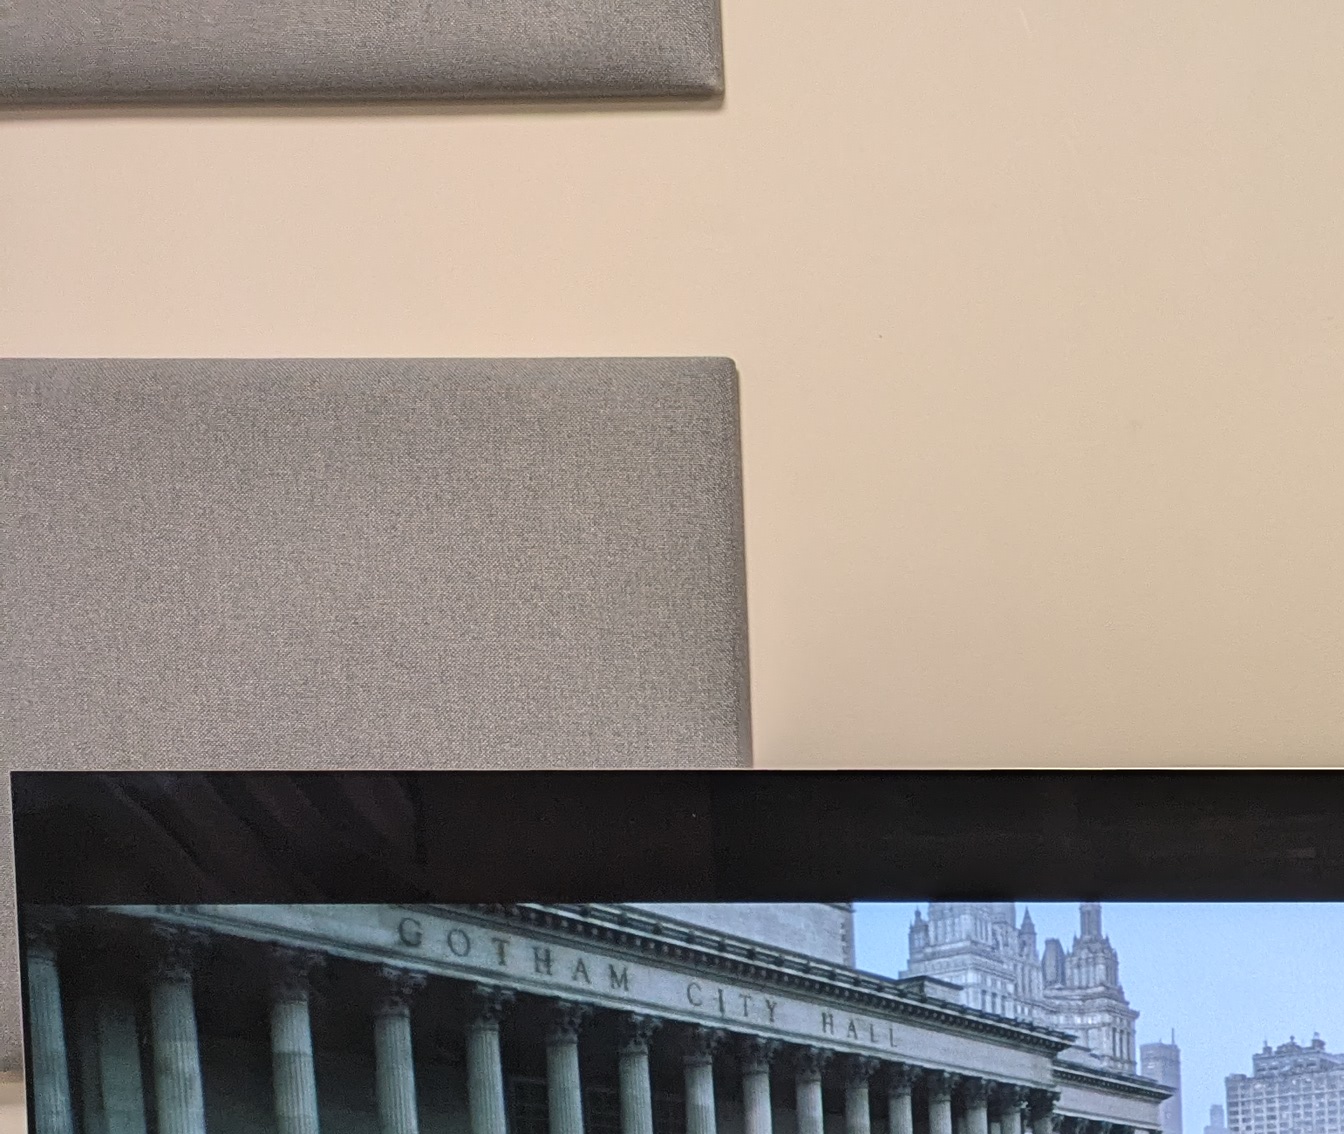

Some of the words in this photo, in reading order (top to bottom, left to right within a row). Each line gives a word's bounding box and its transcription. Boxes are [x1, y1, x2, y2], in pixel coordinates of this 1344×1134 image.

[397, 917, 630, 992] GOTHAM
[686, 981, 778, 1023] CITY
[821, 1011, 898, 1048] HALL
